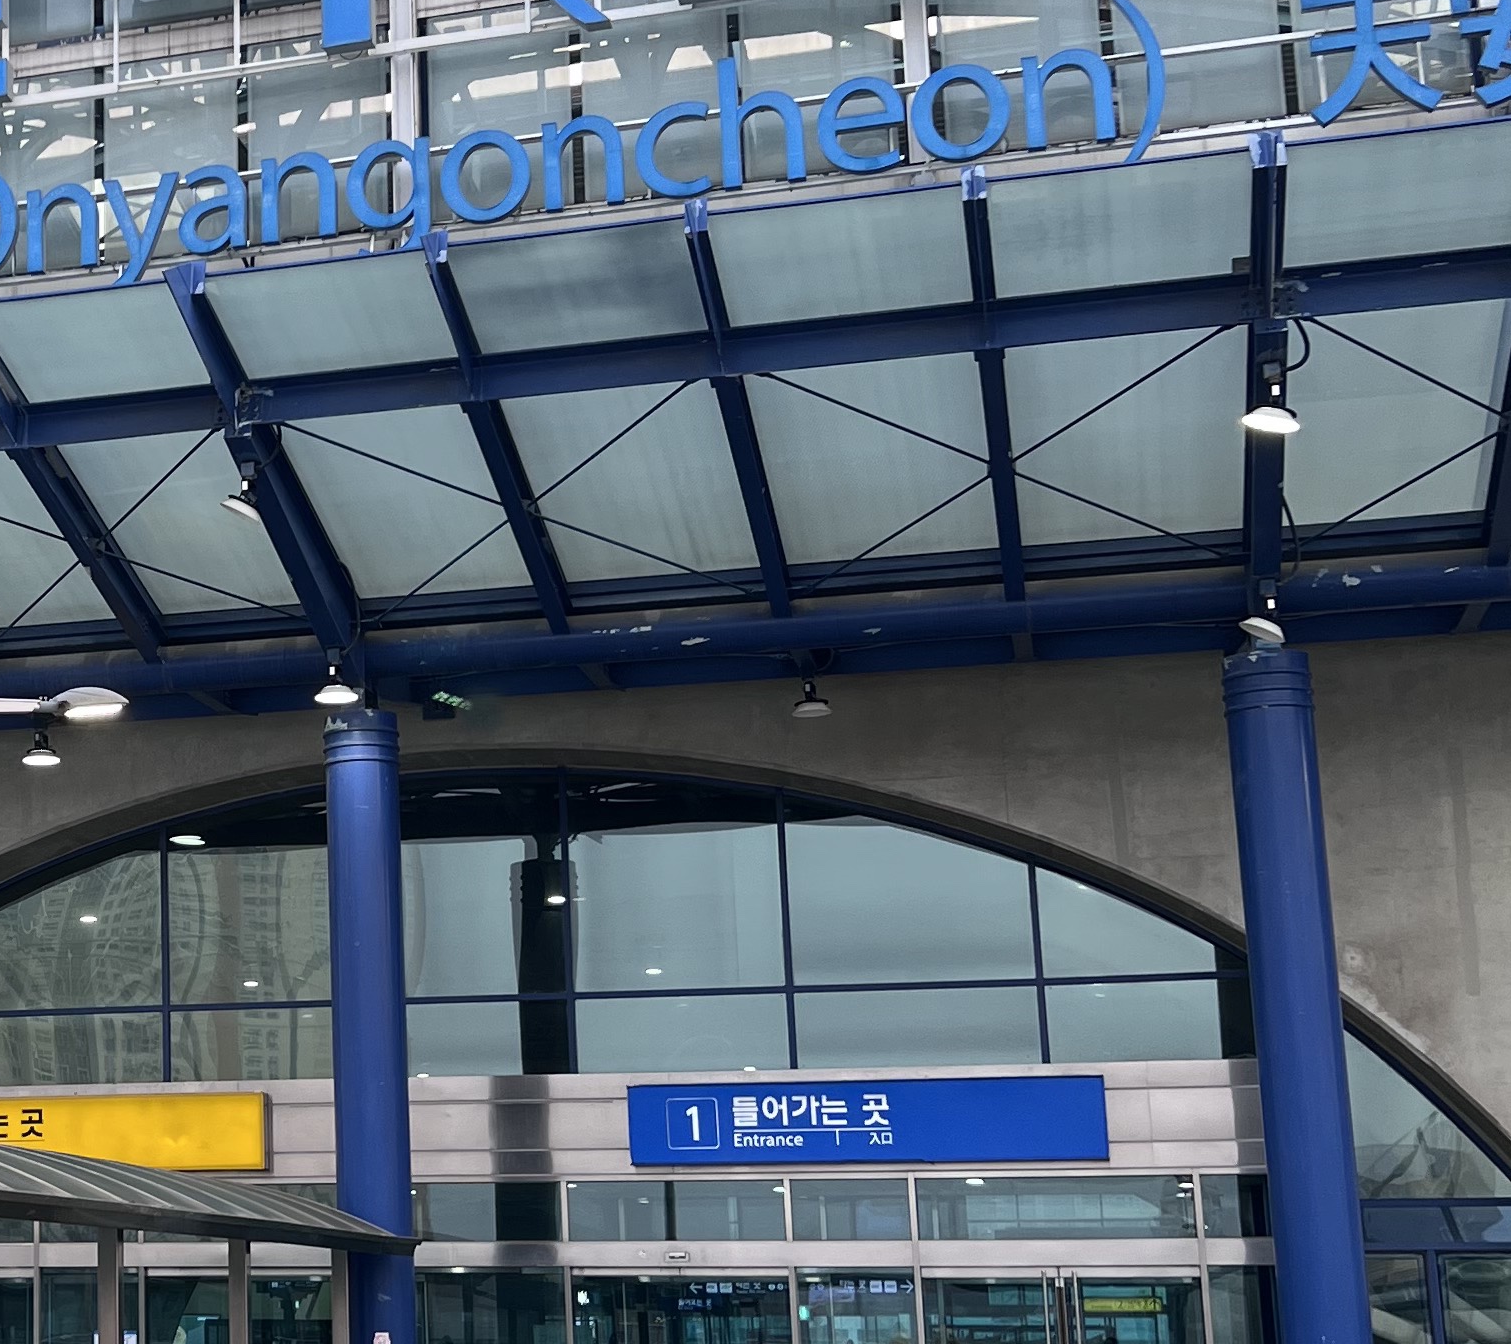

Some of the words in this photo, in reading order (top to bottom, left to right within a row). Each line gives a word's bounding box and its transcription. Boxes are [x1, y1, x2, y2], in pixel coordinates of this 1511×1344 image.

[20, 1108, 44, 1138] 곳
[684, 1105, 700, 1142] 1
[731, 1093, 848, 1127] 들어가는
[861, 1093, 890, 1126] 곳
[733, 1132, 804, 1148] Entrance
